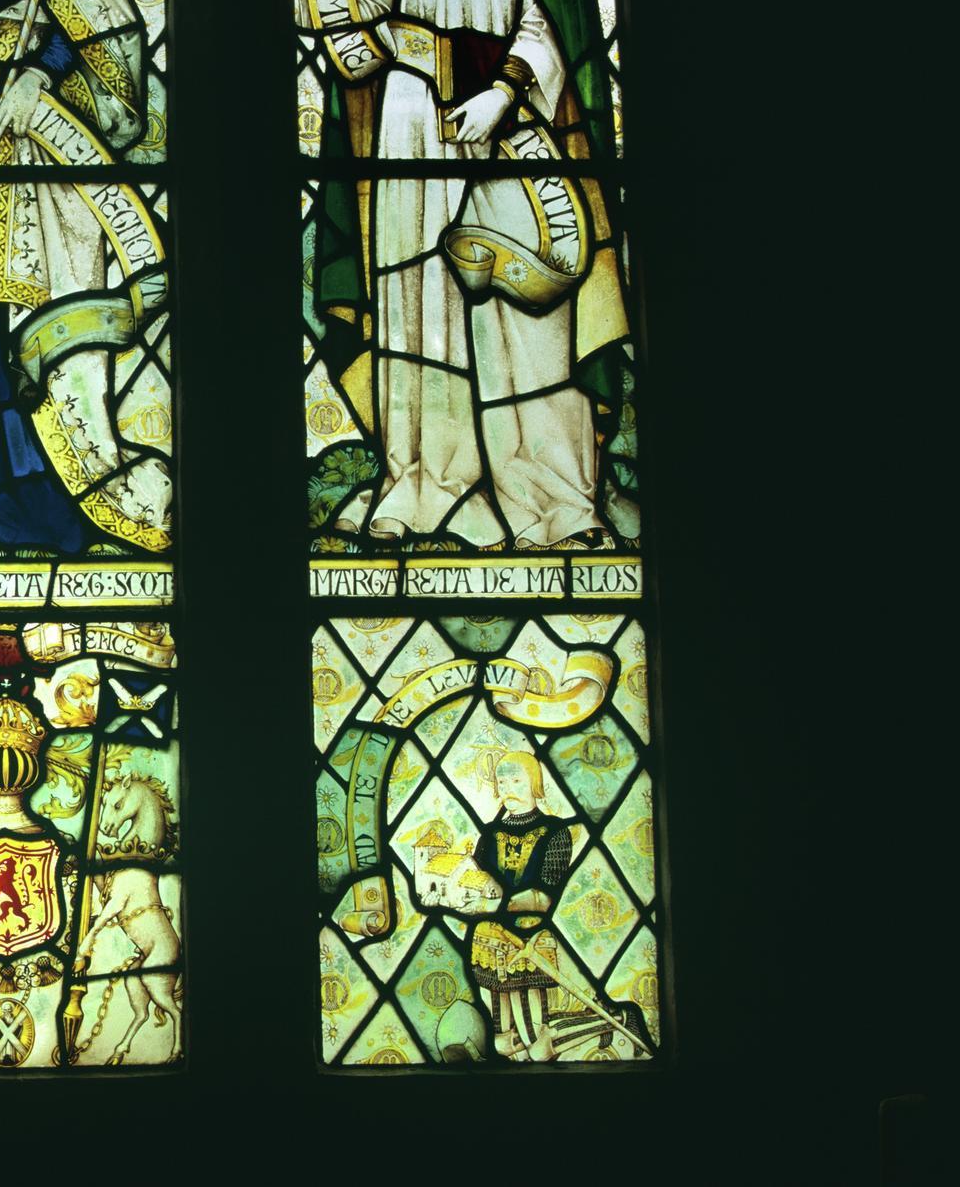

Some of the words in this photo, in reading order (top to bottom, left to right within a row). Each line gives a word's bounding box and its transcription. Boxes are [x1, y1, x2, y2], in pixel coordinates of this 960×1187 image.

[311, 566, 472, 597] MARGARETA
[480, 566, 514, 594] DE
[524, 563, 639, 594] MARLOS
[427, 665, 517, 696] LEVAVI
[354, 773, 377, 804] TE
[355, 833, 380, 867] AD
